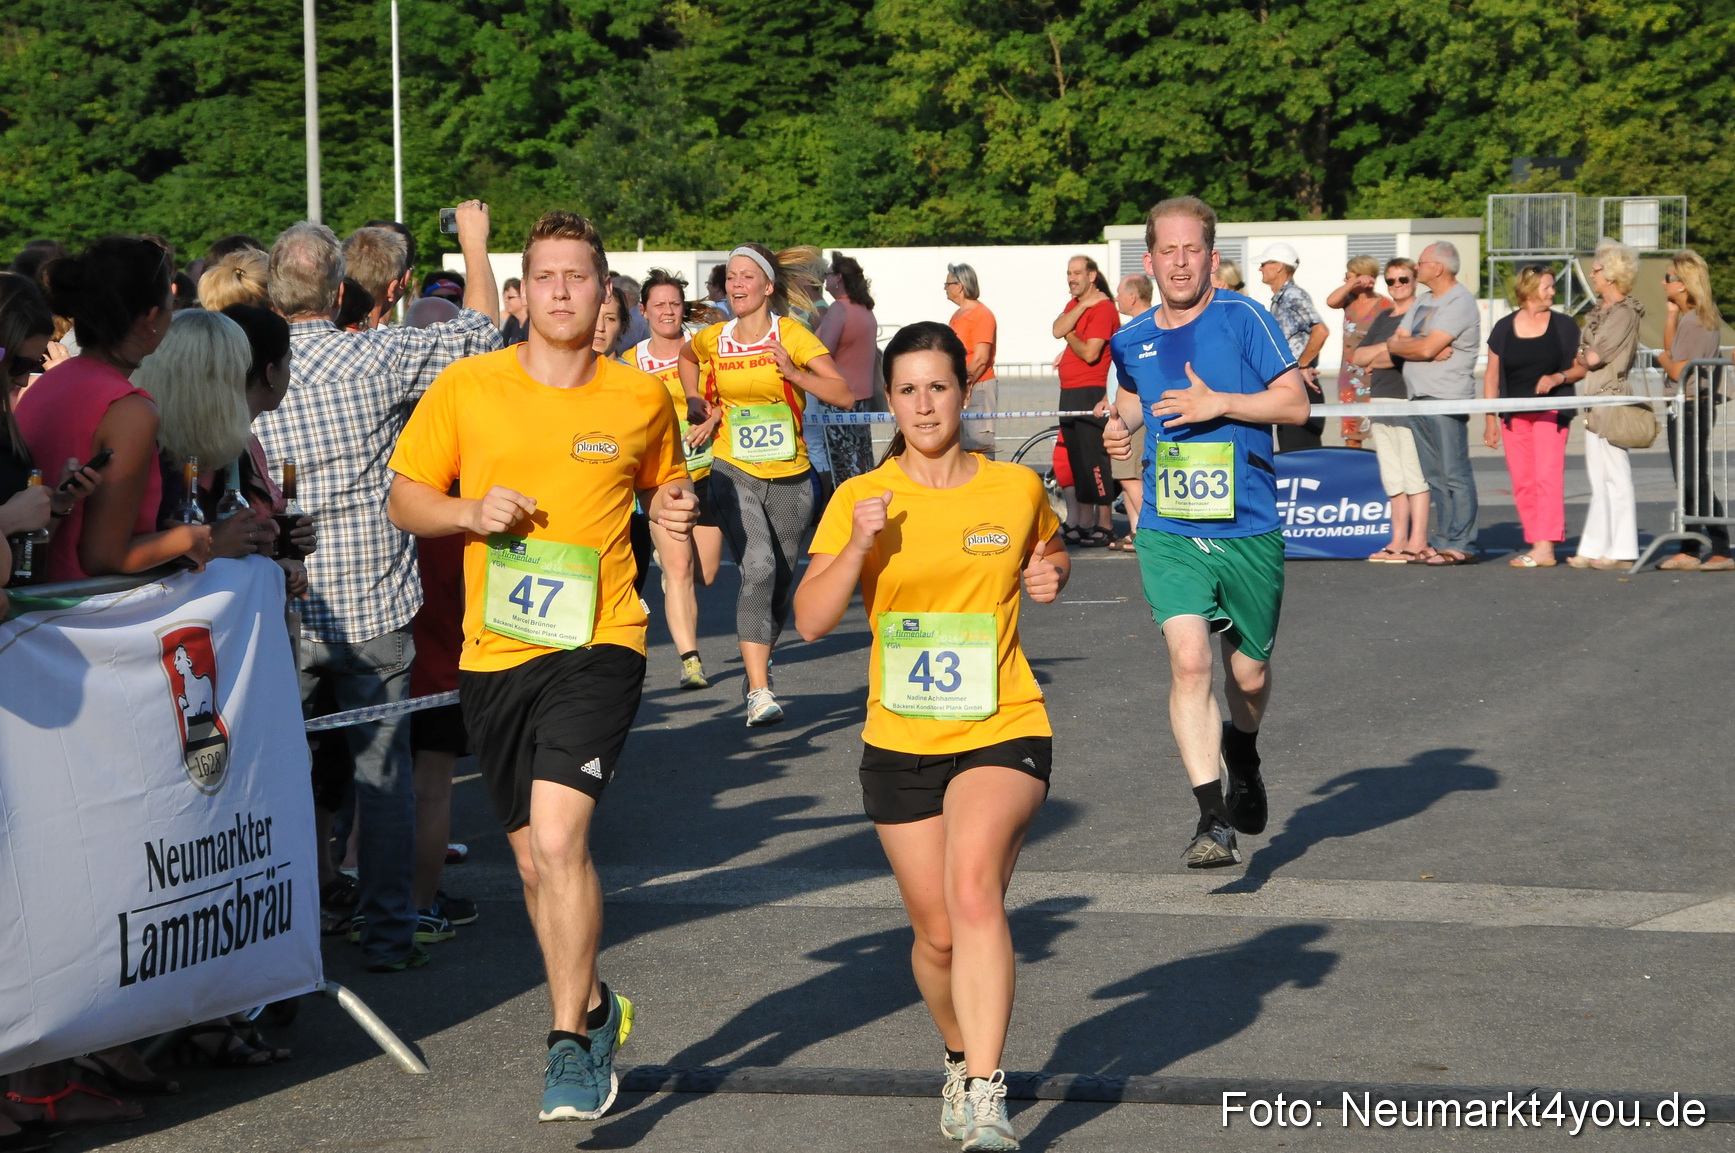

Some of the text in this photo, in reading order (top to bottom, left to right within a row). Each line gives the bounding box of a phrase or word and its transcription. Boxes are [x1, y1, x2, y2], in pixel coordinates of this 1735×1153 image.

[718, 361, 745, 371] MAX
[738, 423, 785, 449] 825
[576, 441, 605, 454] plank
[1158, 468, 1230, 500] 1363
[1282, 523, 1391, 538] AUTOMOBILE
[967, 533, 997, 547] plank
[502, 549, 541, 564] firmenlauf
[508, 574, 565, 619] 47
[492, 617, 514, 629] Bäckerei
[514, 624, 541, 636] Konditorei
[541, 630, 558, 638] Plank
[558, 633, 578, 641] GmbH
[512, 614, 557, 629] Marcel Brünner
[895, 629, 935, 639] firmenlauf
[908, 650, 962, 693] 43
[906, 694, 967, 702] Nadine Achhammer
[916, 703, 945, 711] Konditorei
[195, 751, 221, 778] 1628
[144, 811, 272, 892] Neumarkter
[118, 866, 292, 988] Lammsbräu
